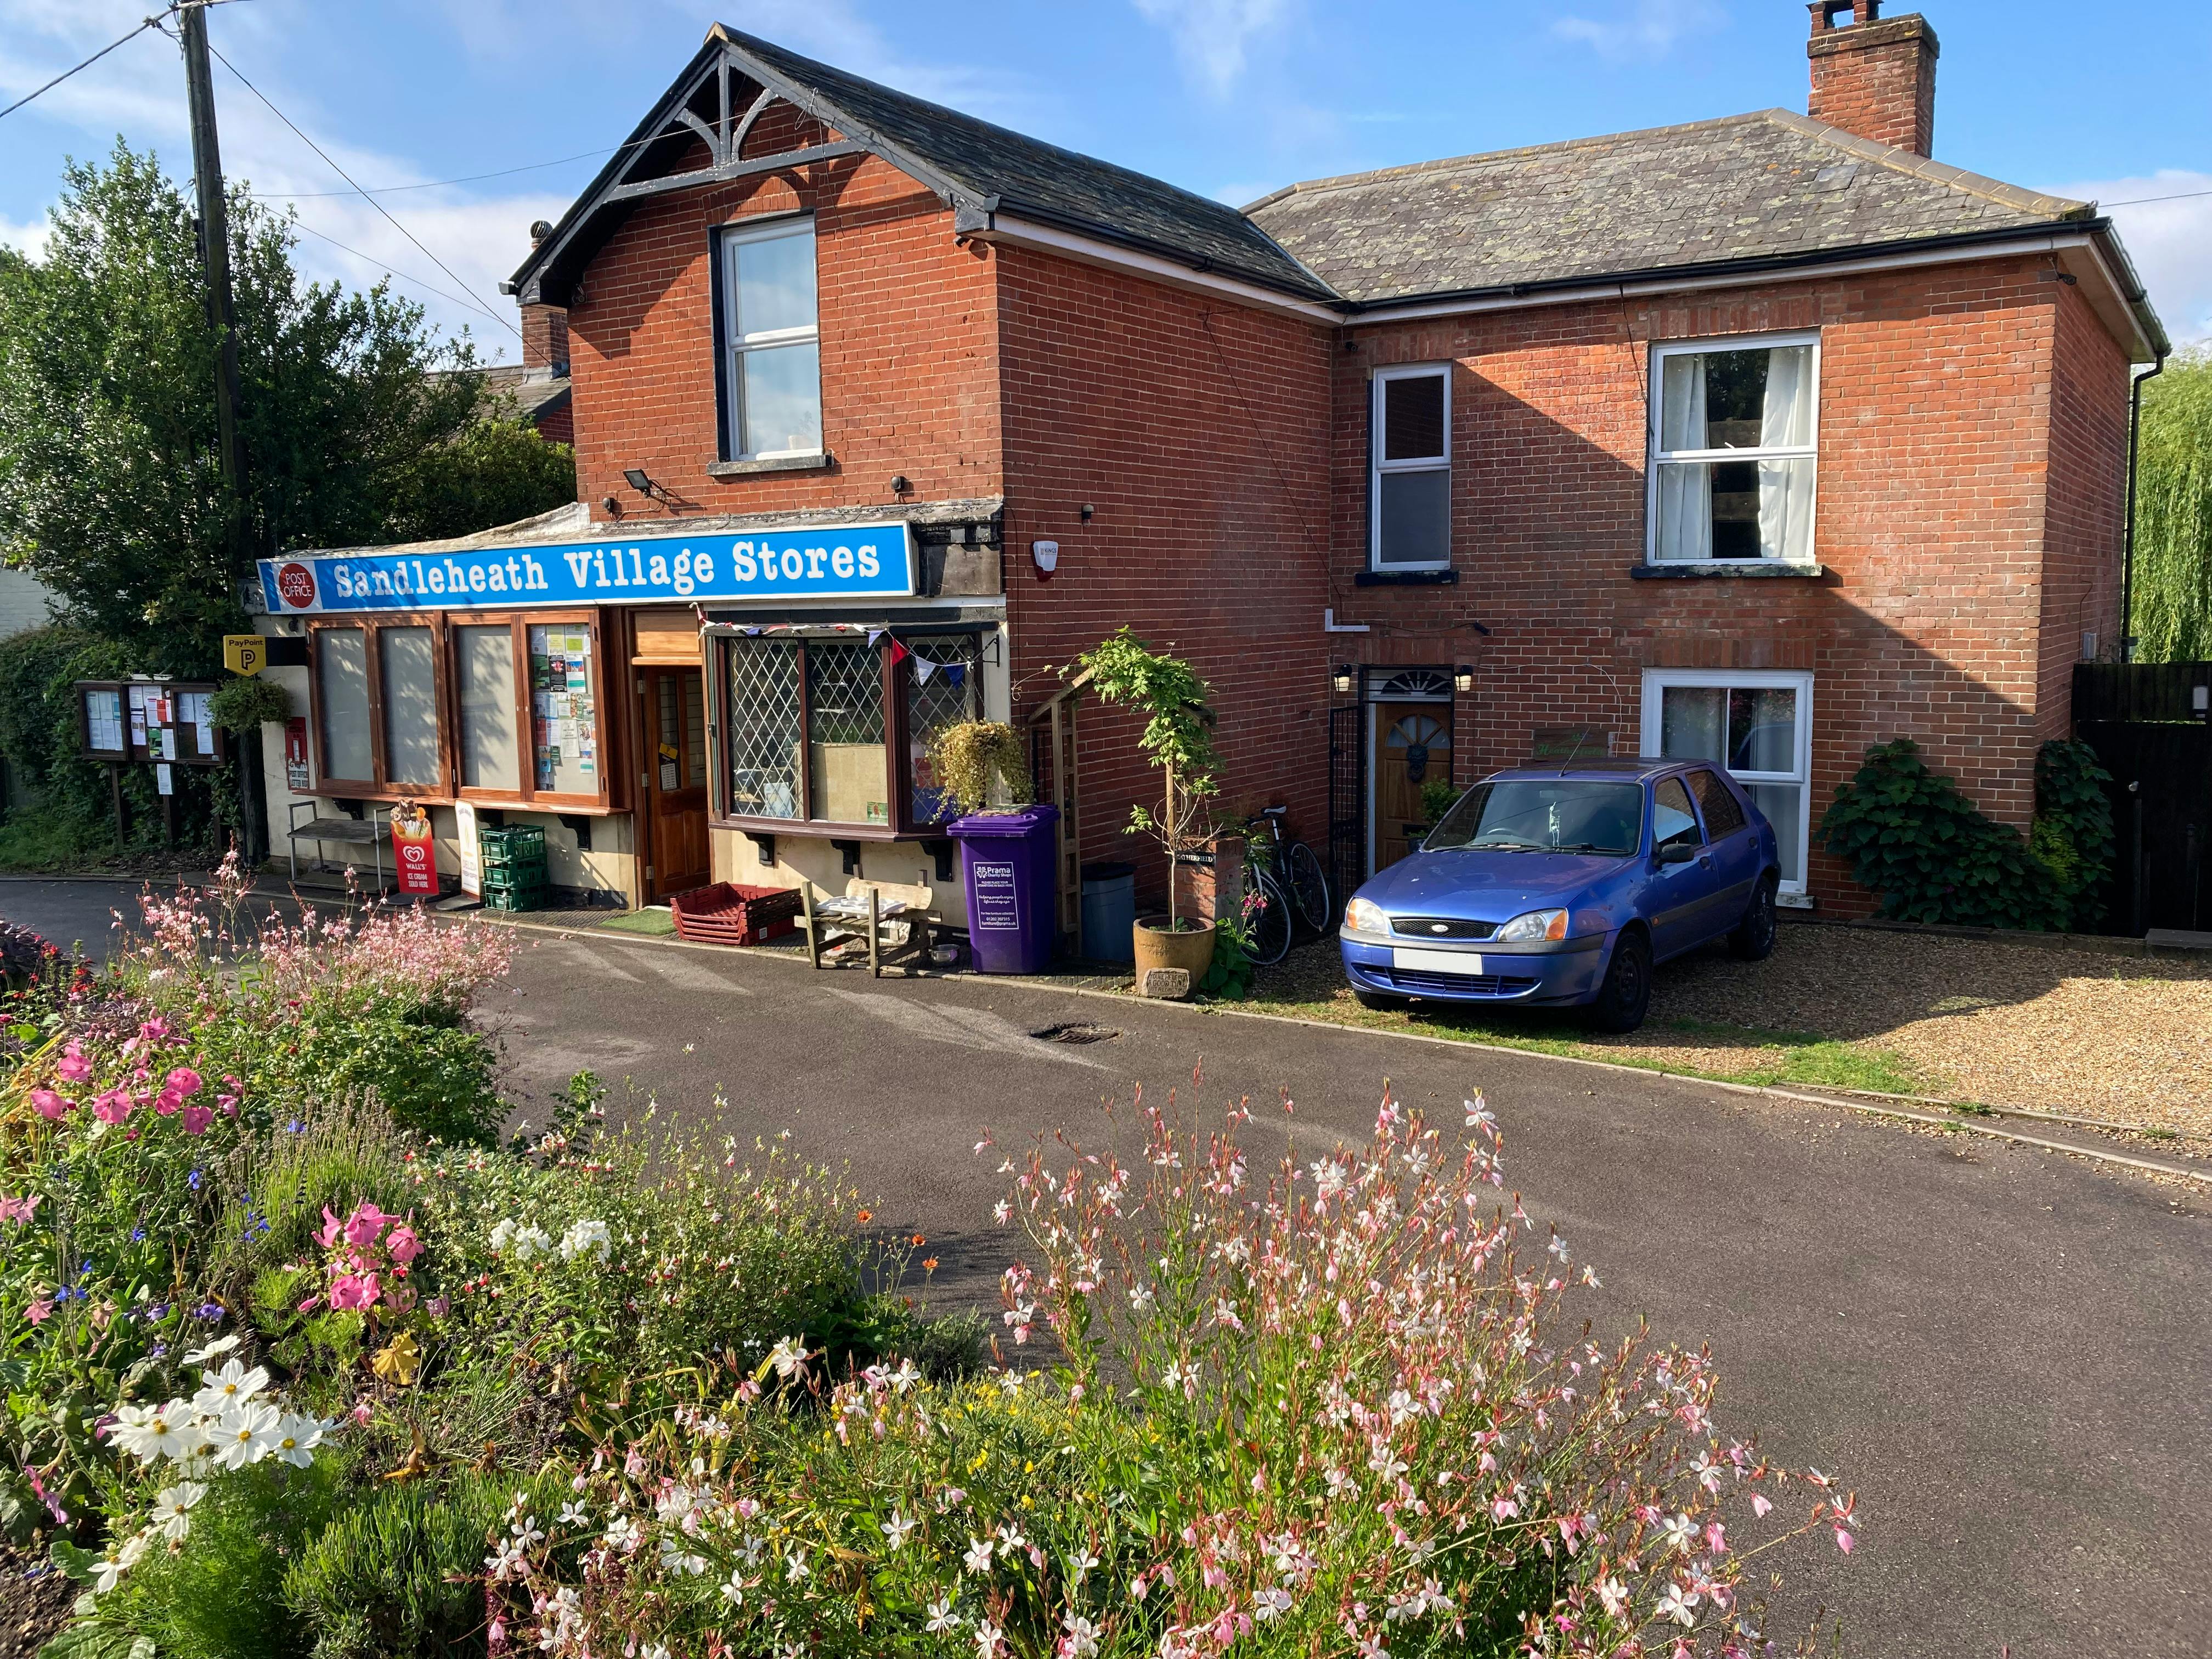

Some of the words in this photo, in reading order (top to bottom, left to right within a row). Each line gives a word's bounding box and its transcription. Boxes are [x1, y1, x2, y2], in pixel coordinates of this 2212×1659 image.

[334, 554, 548, 598] Sandleheath
[564, 548, 715, 595] Village
[732, 541, 880, 582] Stores
[285, 572, 306, 585] POST
[283, 585, 312, 597] OFFICE
[228, 639, 263, 647] PayPoint
